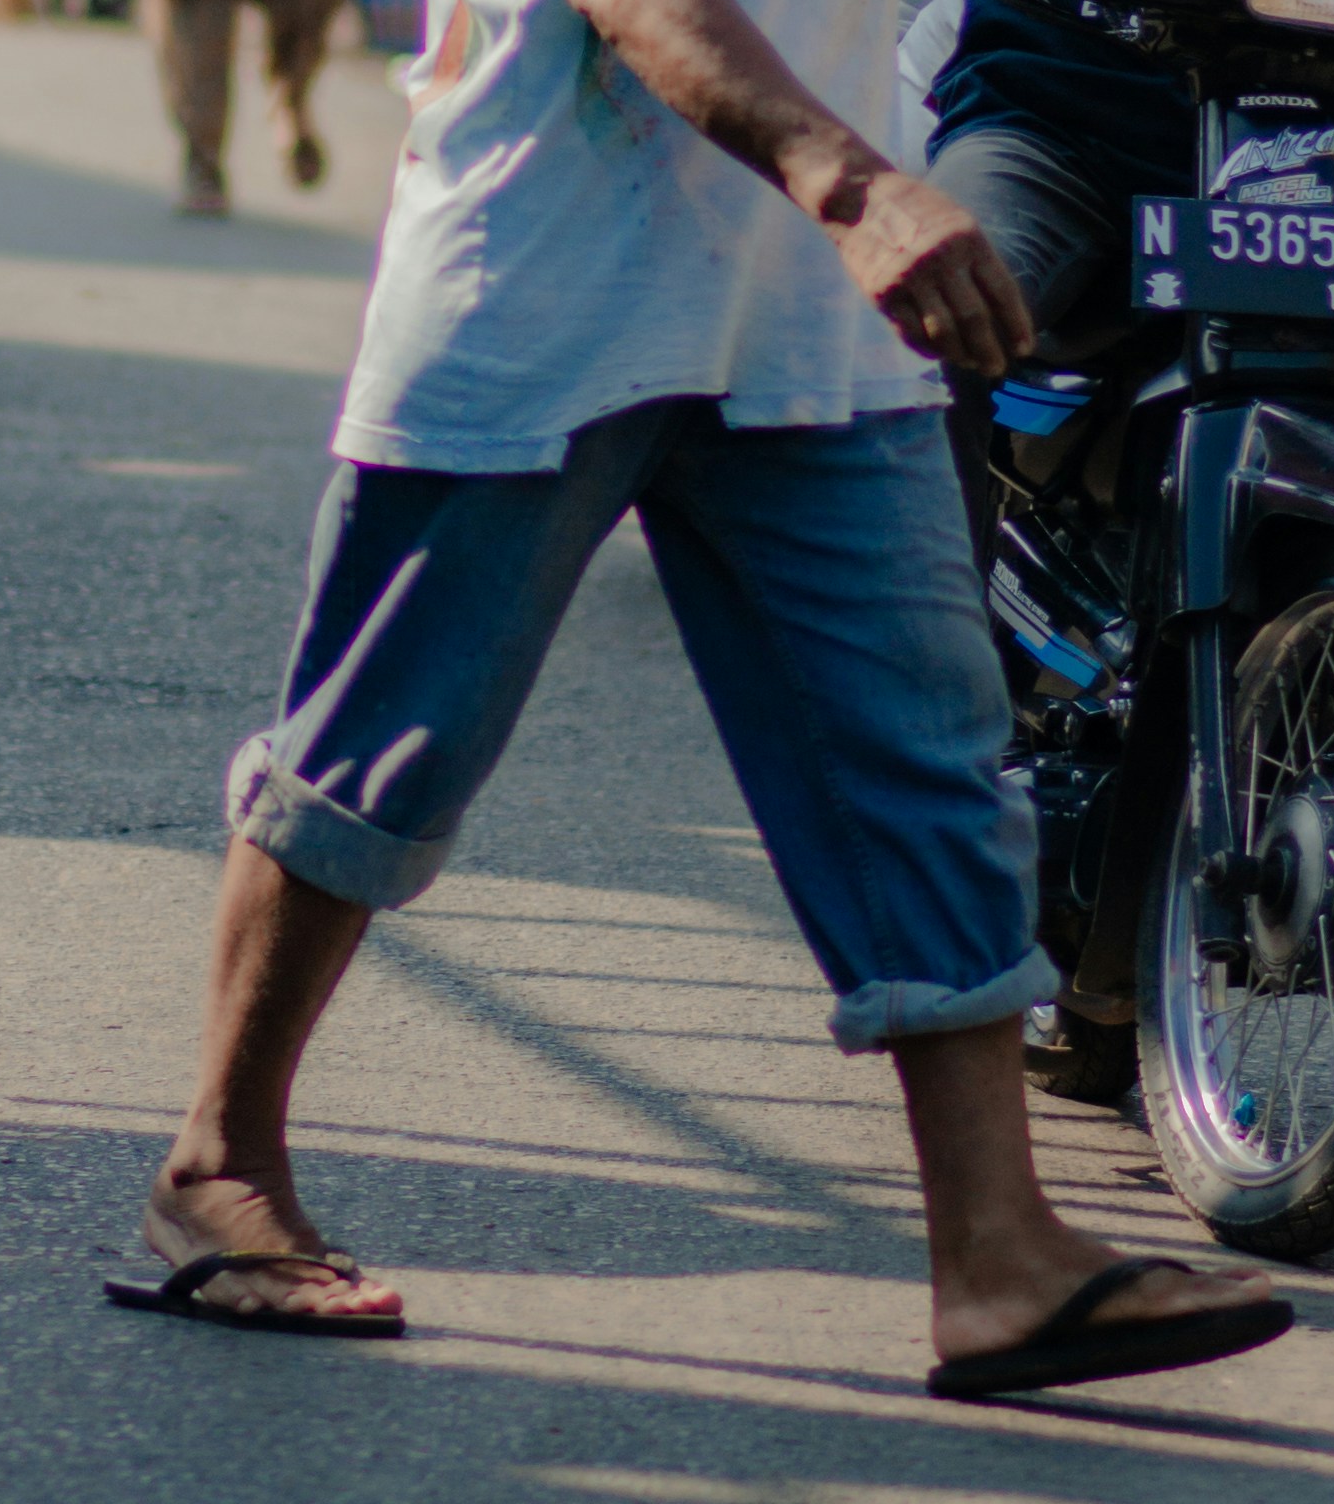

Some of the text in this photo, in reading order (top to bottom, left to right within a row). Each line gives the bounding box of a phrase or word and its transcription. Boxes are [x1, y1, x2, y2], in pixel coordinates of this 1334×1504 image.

[1237, 95, 1319, 109] HONDA
[1242, 177, 1312, 199] MOOSE
[1255, 189, 1327, 203] RACING
[1143, 205, 1171, 255] N
